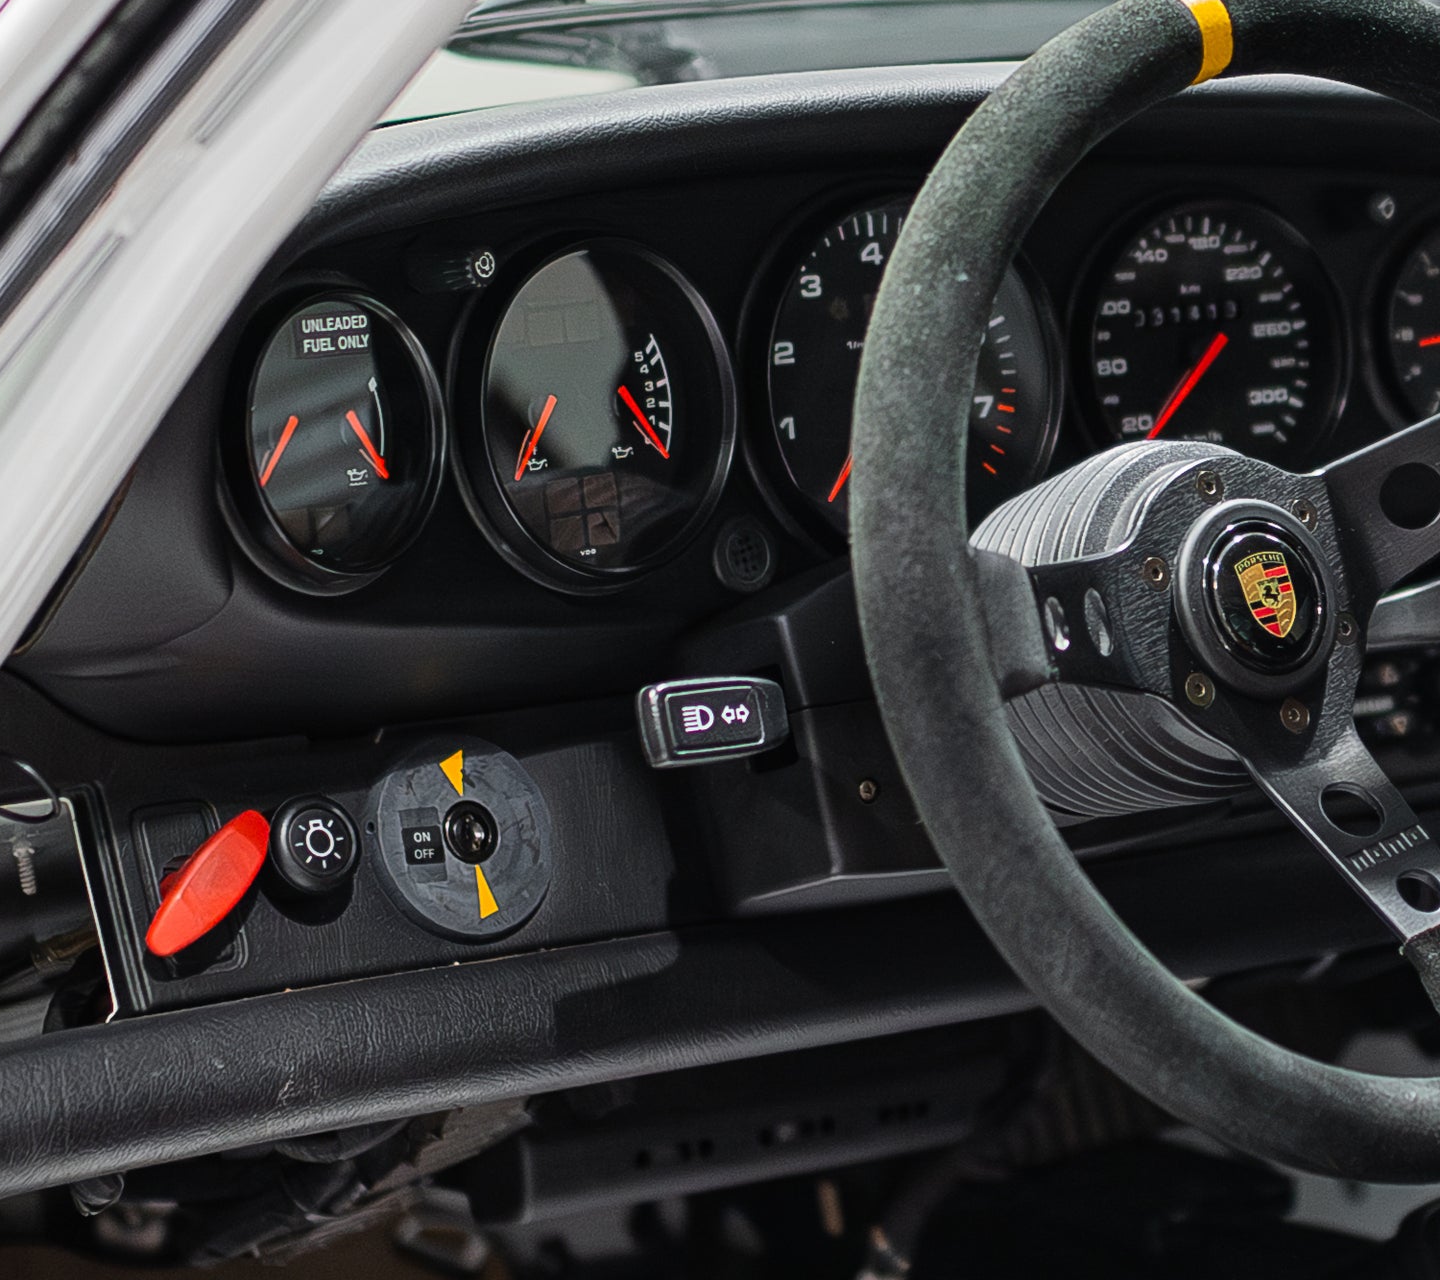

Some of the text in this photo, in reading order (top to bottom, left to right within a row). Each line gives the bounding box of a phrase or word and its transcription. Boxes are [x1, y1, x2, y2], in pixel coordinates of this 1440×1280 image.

[861, 242, 884, 265] 4
[800, 275, 822, 298] 3
[301, 315, 368, 334] UNLEADED
[303, 334, 370, 354] FUEL ONLY
[774, 341, 796, 365] 2
[634, 351, 644, 362] 5
[640, 364, 650, 374] 4
[644, 381, 654, 392] 3
[646, 398, 656, 409] 2
[973, 395, 994, 418] 7
[648, 415, 656, 426] 1
[779, 417, 796, 440] 1
[1237, 554, 1281, 573] PORSCHE
[413, 832, 431, 843] ON
[414, 848, 435, 859] OFF
